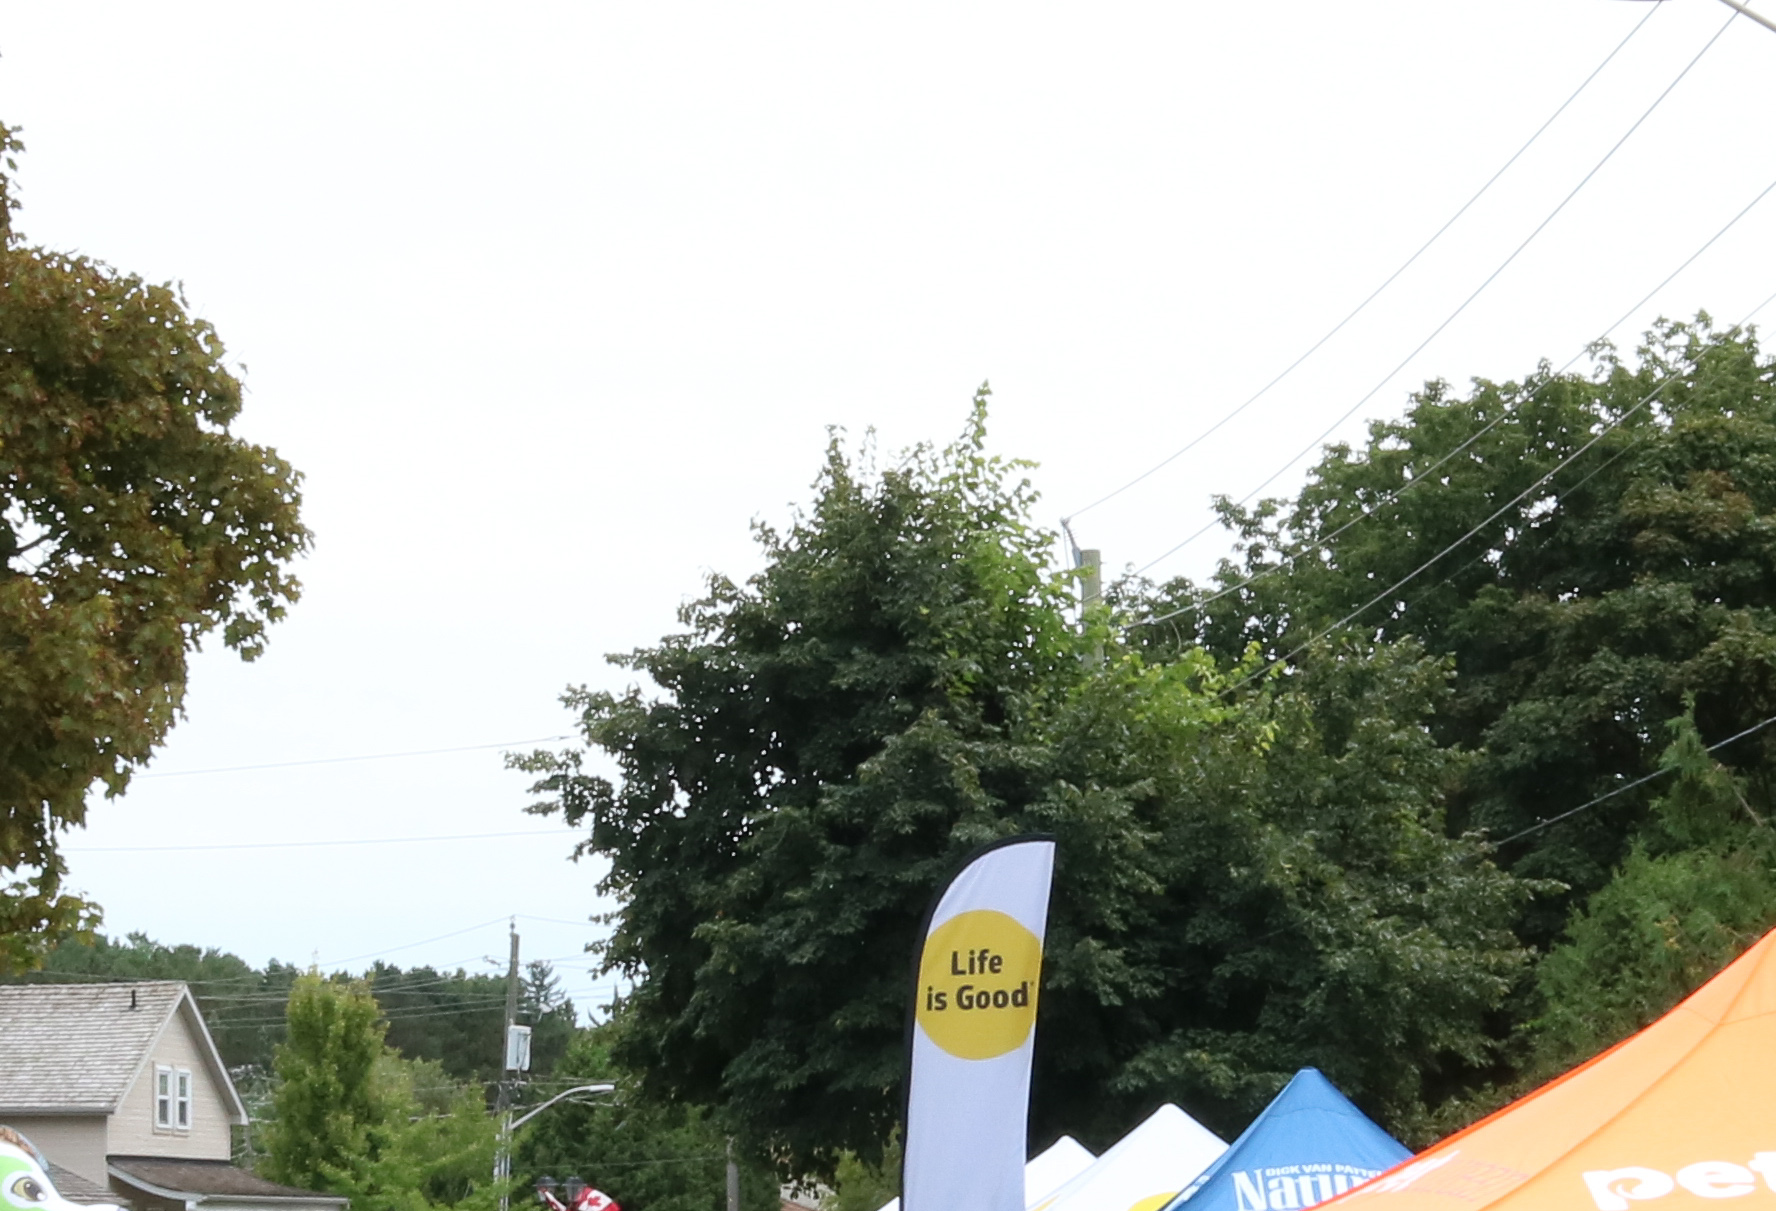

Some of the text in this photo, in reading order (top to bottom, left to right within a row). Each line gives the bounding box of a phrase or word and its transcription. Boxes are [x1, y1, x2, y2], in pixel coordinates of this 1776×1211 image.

[951, 949, 1002, 975] Life
[926, 981, 1028, 1011] is Good
[1266, 1164, 1300, 1176] DICK
[1302, 1162, 1332, 1173] VAN
